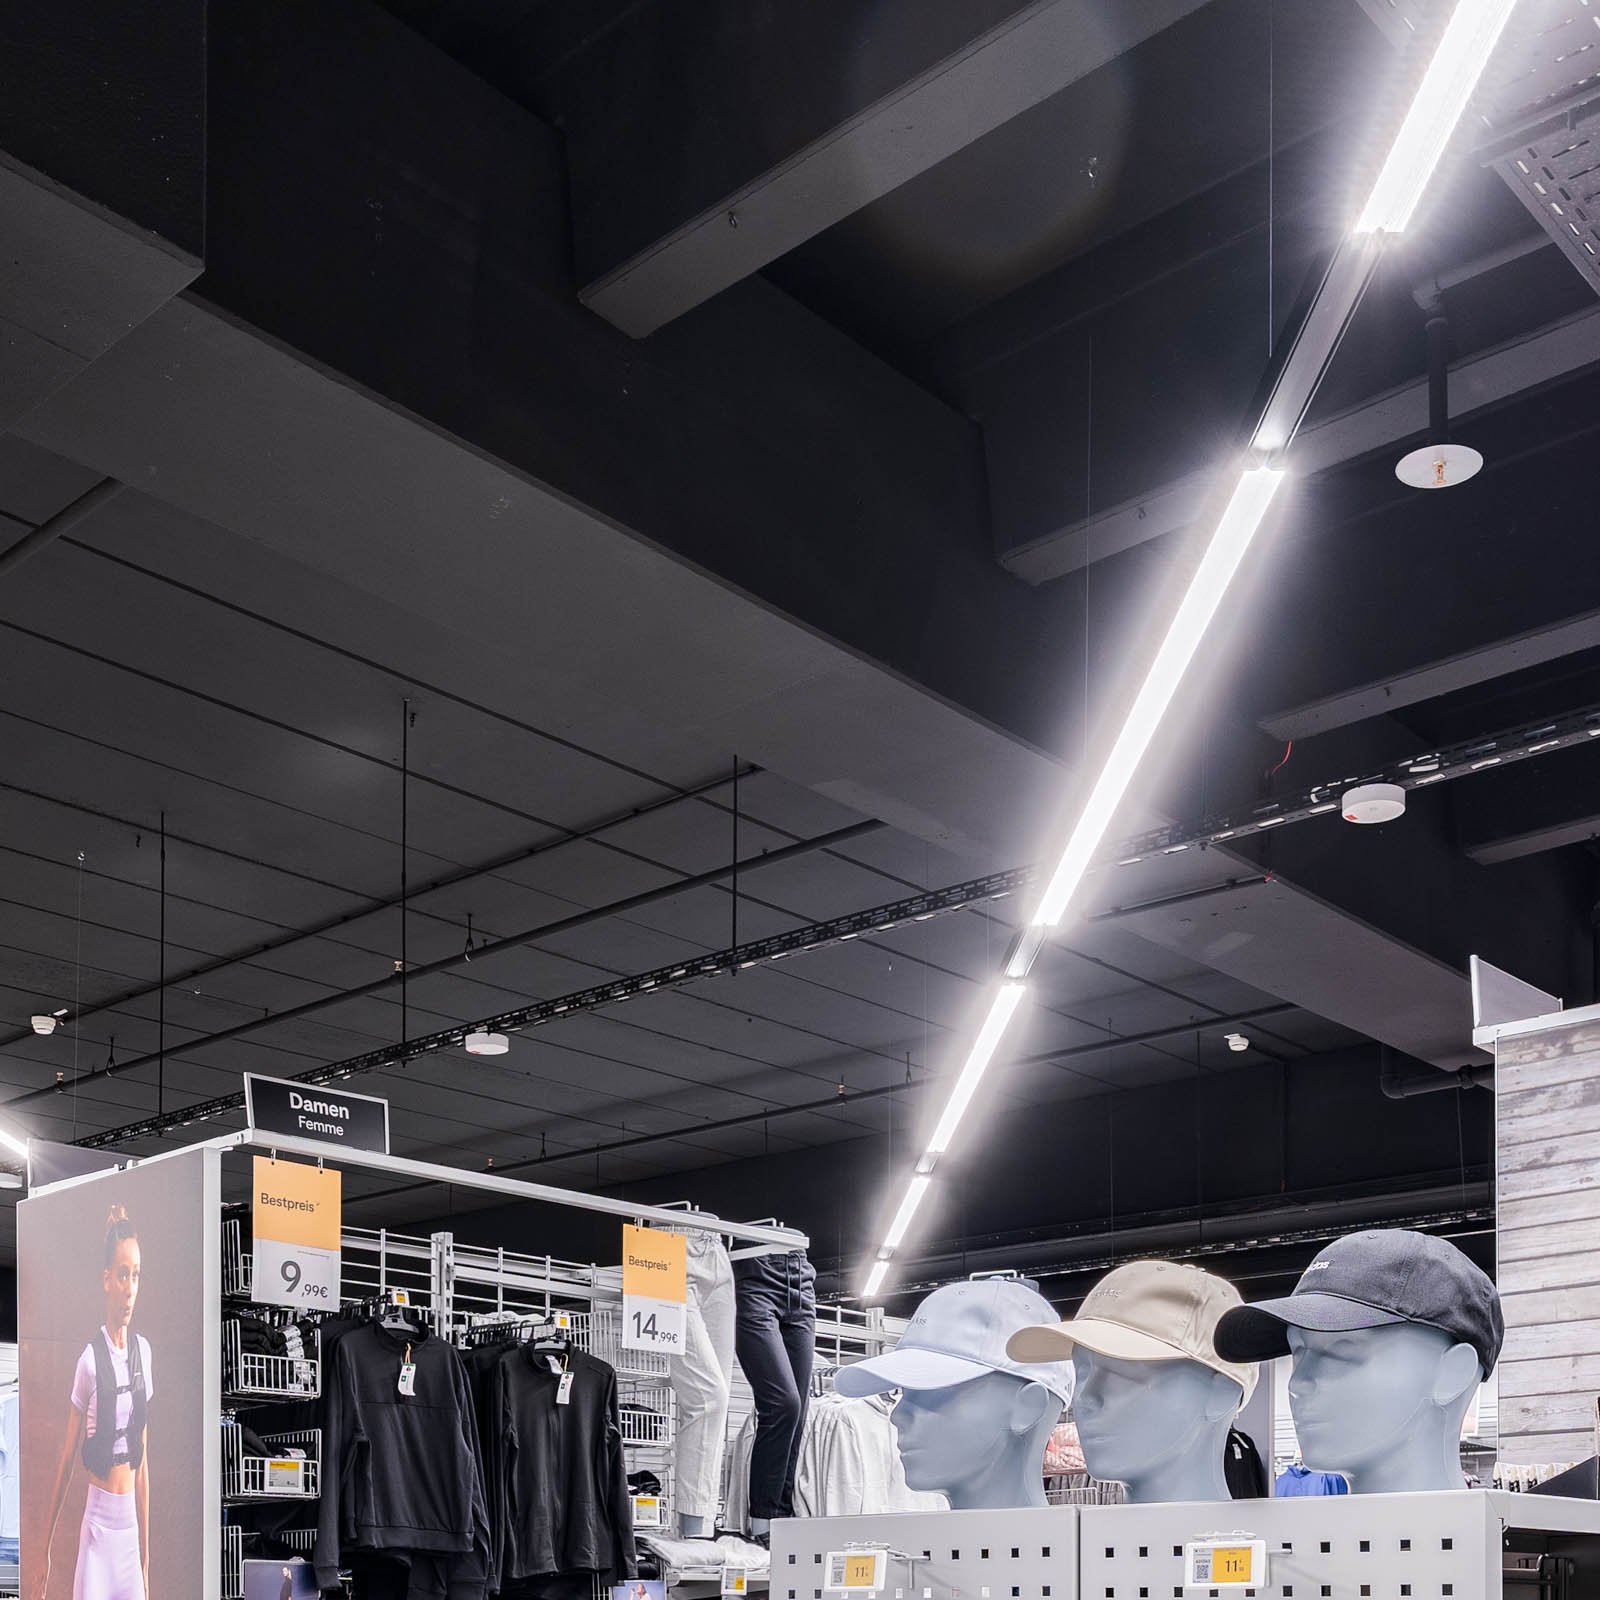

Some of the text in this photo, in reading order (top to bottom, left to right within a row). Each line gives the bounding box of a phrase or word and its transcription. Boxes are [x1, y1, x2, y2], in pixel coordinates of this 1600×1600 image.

[289, 1092, 350, 1120] Damen
[298, 1115, 344, 1136] Femme
[260, 1192, 315, 1213] Bestpreis
[628, 1255, 669, 1271] Bestpreis
